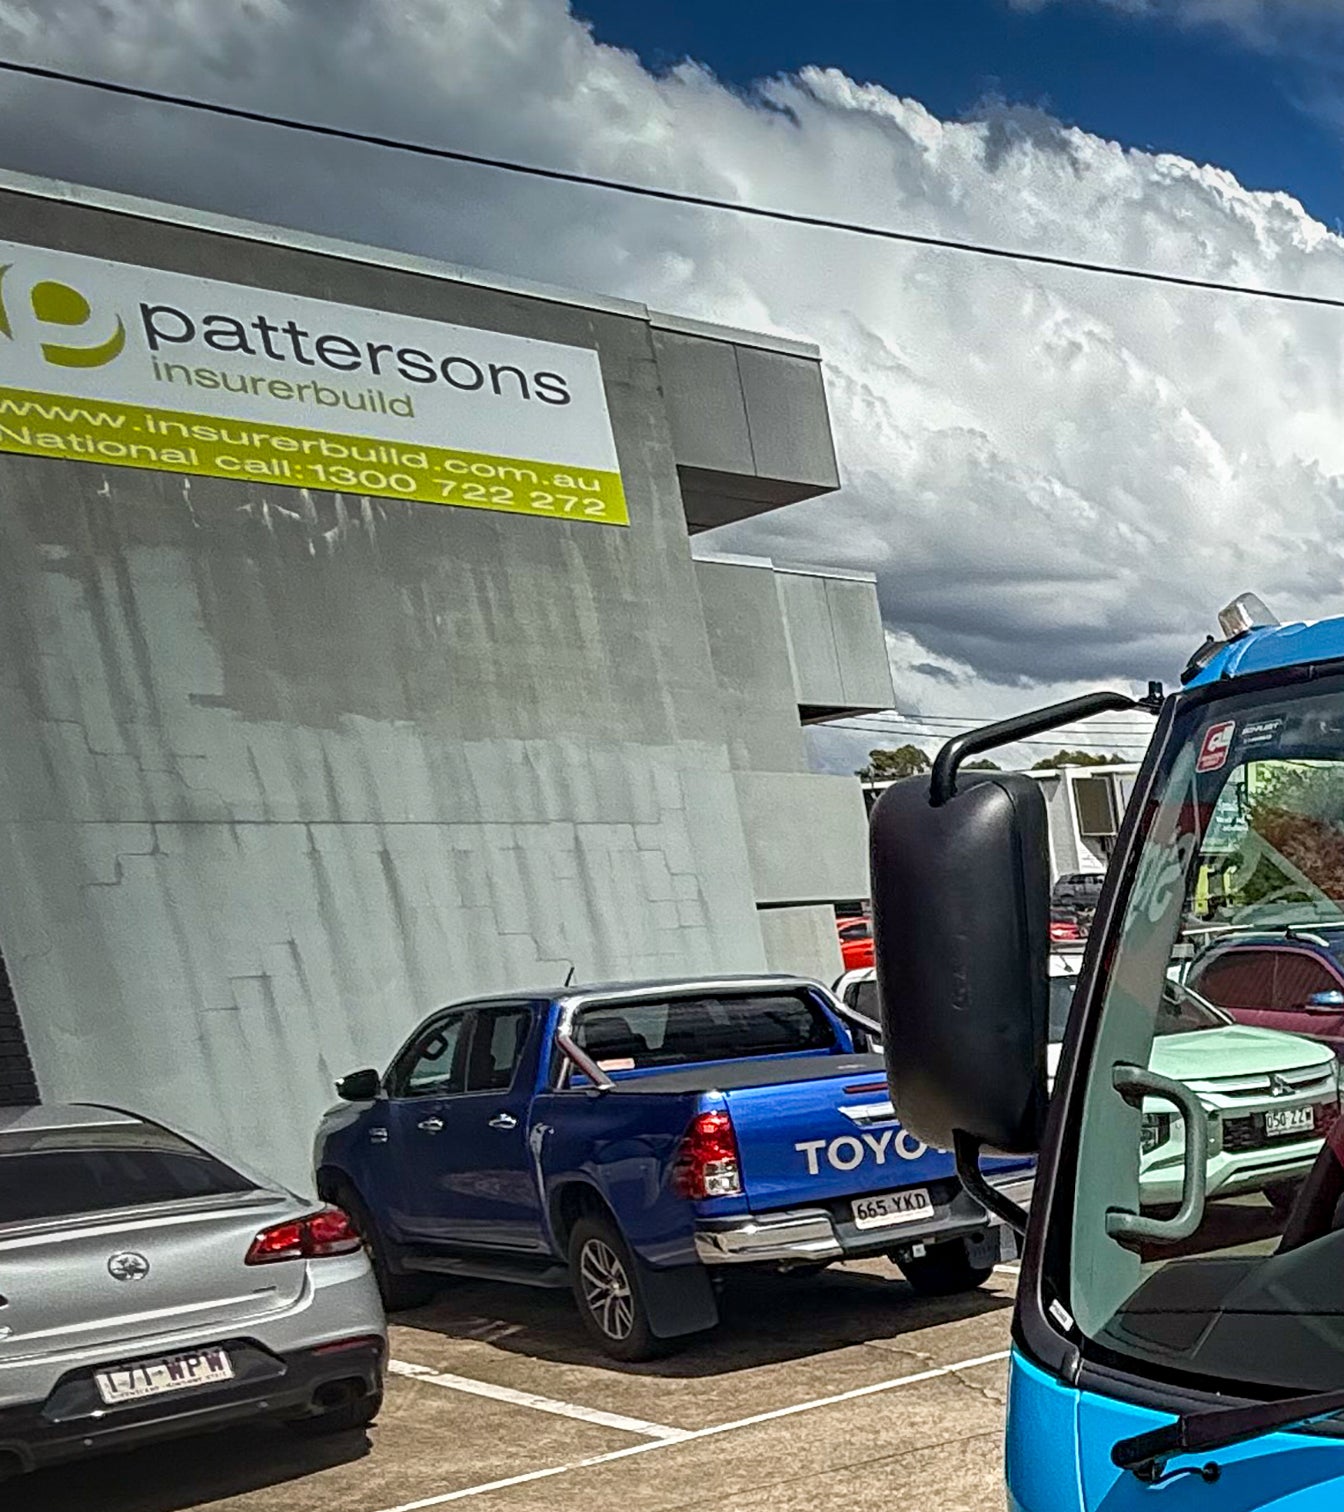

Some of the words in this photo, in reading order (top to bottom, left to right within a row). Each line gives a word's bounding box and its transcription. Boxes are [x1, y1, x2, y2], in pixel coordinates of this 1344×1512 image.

[140, 302, 571, 405] pattersons
[152, 356, 415, 418] insurerbuild
[0, 400, 600, 492] www.insurerbuild.com.au
[432, 479, 514, 505] 722
[529, 491, 606, 516] 272
[795, 1130, 947, 1175] TOYO
[857, 1200, 888, 1220] 665
[892, 1193, 926, 1211] YKD
